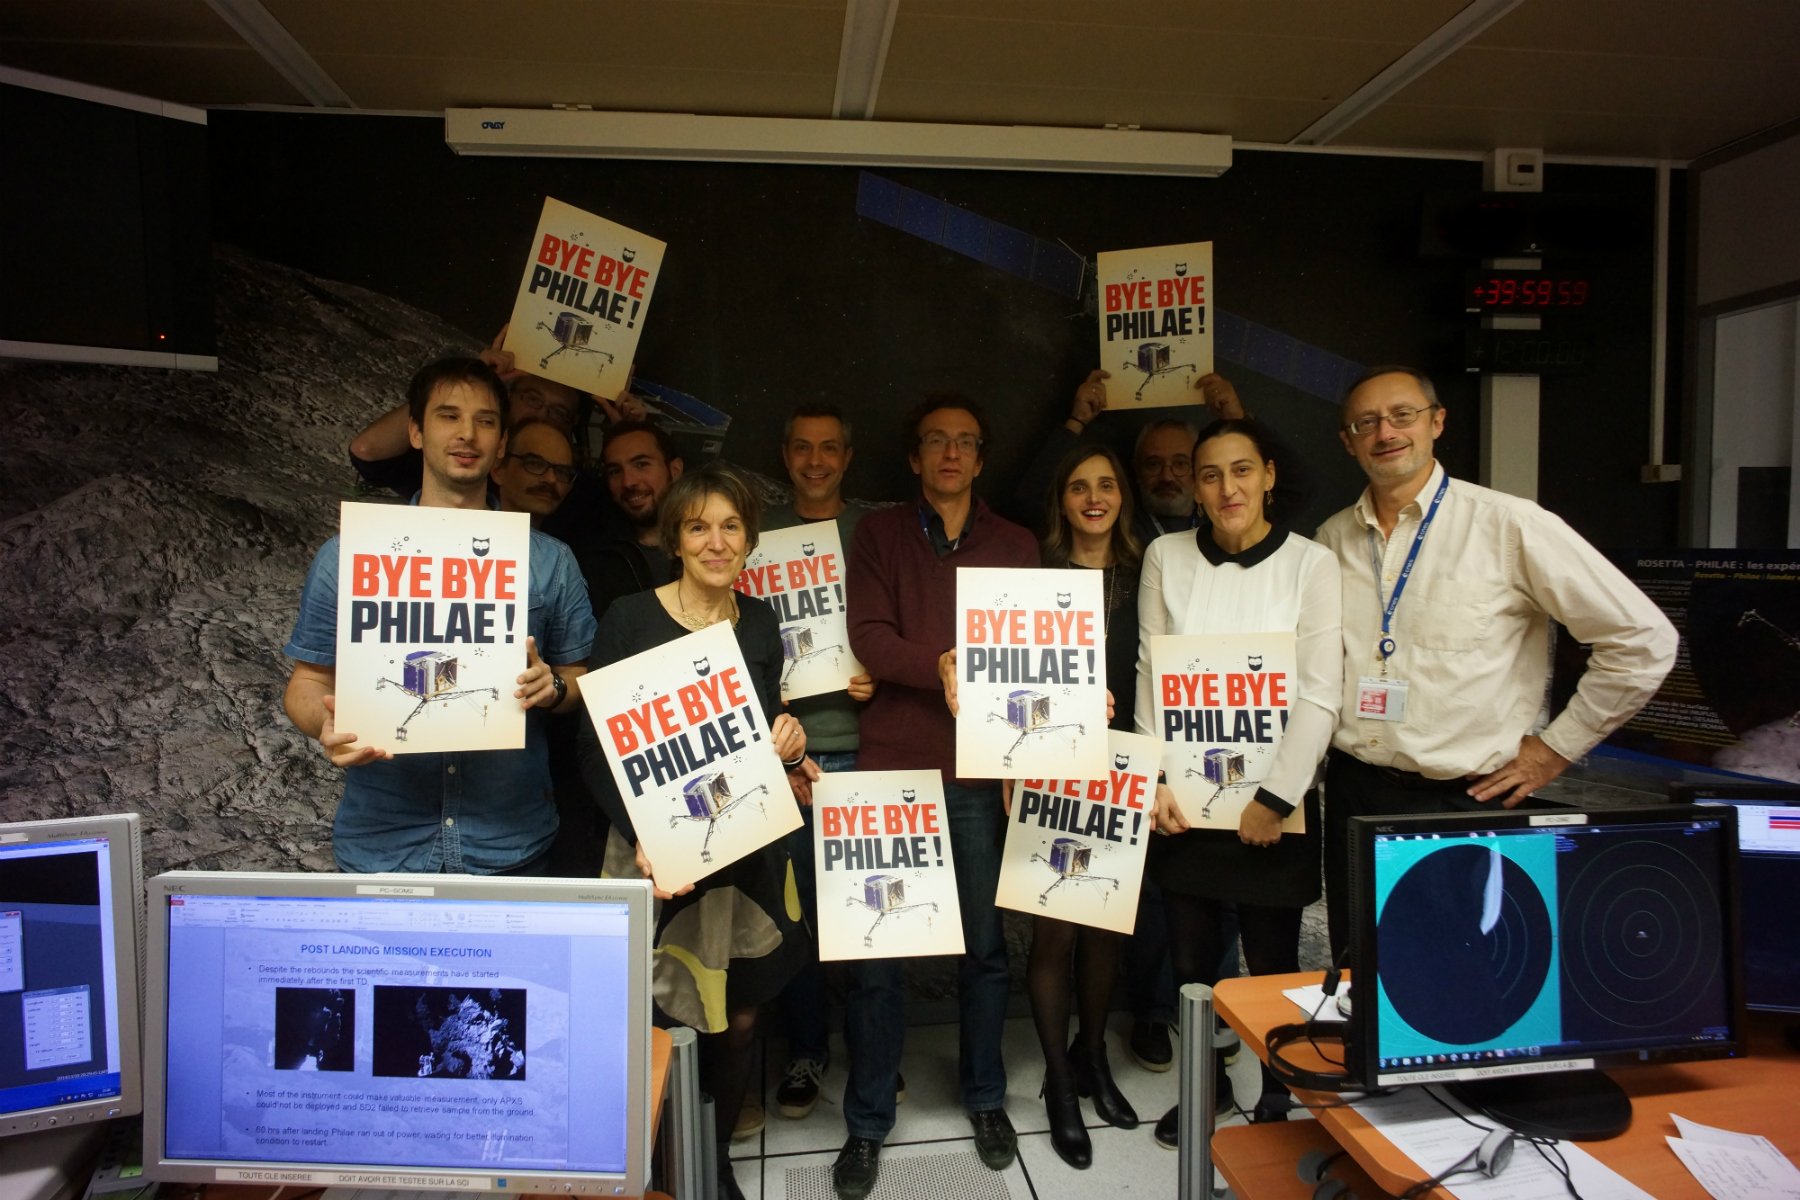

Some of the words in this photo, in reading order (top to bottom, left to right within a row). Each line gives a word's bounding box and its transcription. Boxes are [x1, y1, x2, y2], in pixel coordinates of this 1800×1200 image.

[537, 233, 595, 280] BYE
[594, 254, 650, 299] BYE
[1105, 281, 1153, 312] BYE
[1157, 275, 1205, 308] BYE
[786, 553, 840, 590] BYE
[1637, 559, 1685, 568] ROSETTA
[1695, 560, 1737, 569] PHILAE
[1747, 561, 1764, 570] les
[352, 553, 433, 598] BYE
[441, 557, 517, 600] BYE
[966, 608, 1027, 645] BYE
[1033, 610, 1095, 646] BYE
[1161, 673, 1220, 707] BYE
[1225, 672, 1288, 707] BYE
[605, 694, 682, 757] BYE
[676, 666, 748, 727] BYE
[1086, 769, 1148, 810] BYE
[822, 805, 879, 837] BYE
[883, 803, 940, 835] BYE
[301, 944, 329, 954] POST
[332, 945, 380, 956] LANDING
[383, 946, 427, 957] MISSION
[430, 947, 492, 958] EXECUTION
[259, 965, 288, 975] Despite
[290, 966, 302, 974] the
[304, 966, 340, 975] rebounds
[342, 967, 354, 975] the
[356, 967, 389, 976] scientific
[391, 969, 449, 977] measurements
[451, 970, 470, 978] have
[472, 970, 499, 979] started
[259, 975, 303, 985] immediately
[306, 976, 324, 985] after
[326, 977, 338, 985] the
[340, 977, 355, 985] first
[256, 1090, 275, 1098] Most
[277, 1090, 285, 1098] of
[287, 1090, 299, 1098] the
[301, 1091, 341, 1100] instrument
[343, 1092, 364, 1100] could
[366, 1093, 389, 1101] make
[482, 1097, 498, 1106] only
[500, 1097, 523, 1106] APXS
[256, 1100, 277, 1109] could
[305, 1102, 340, 1112] deployed
[342, 1103, 357, 1111] and
[360, 1103, 376, 1112] SD2
[378, 1103, 399, 1112] failed
[410, 1105, 439, 1113] retrieve
[442, 1106, 470, 1115] sample
[472, 1107, 490, 1115] from
[492, 1107, 504, 1116] the
[255, 1137, 290, 1146] condition
[292, 1138, 300, 1146] to
[267, 1126, 280, 1135] hrs
[282, 1127, 299, 1135] after
[301, 1127, 329, 1137] landing
[331, 1128, 355, 1137] Philae
[372, 1129, 385, 1137] out
[387, 1129, 395, 1137] of
[453, 1131, 466, 1140] for
[466, 1132, 488, 1141] better
[238, 1171, 263, 1180] TOUTE
[264, 1172, 279, 1180] CLE
[358, 1175, 381, 1183] AVOIR
[382, 1176, 397, 1184] ETE
[399, 1177, 427, 1185] TESTEE
[428, 1177, 444, 1186] SUR
[445, 1178, 455, 1186] LA
